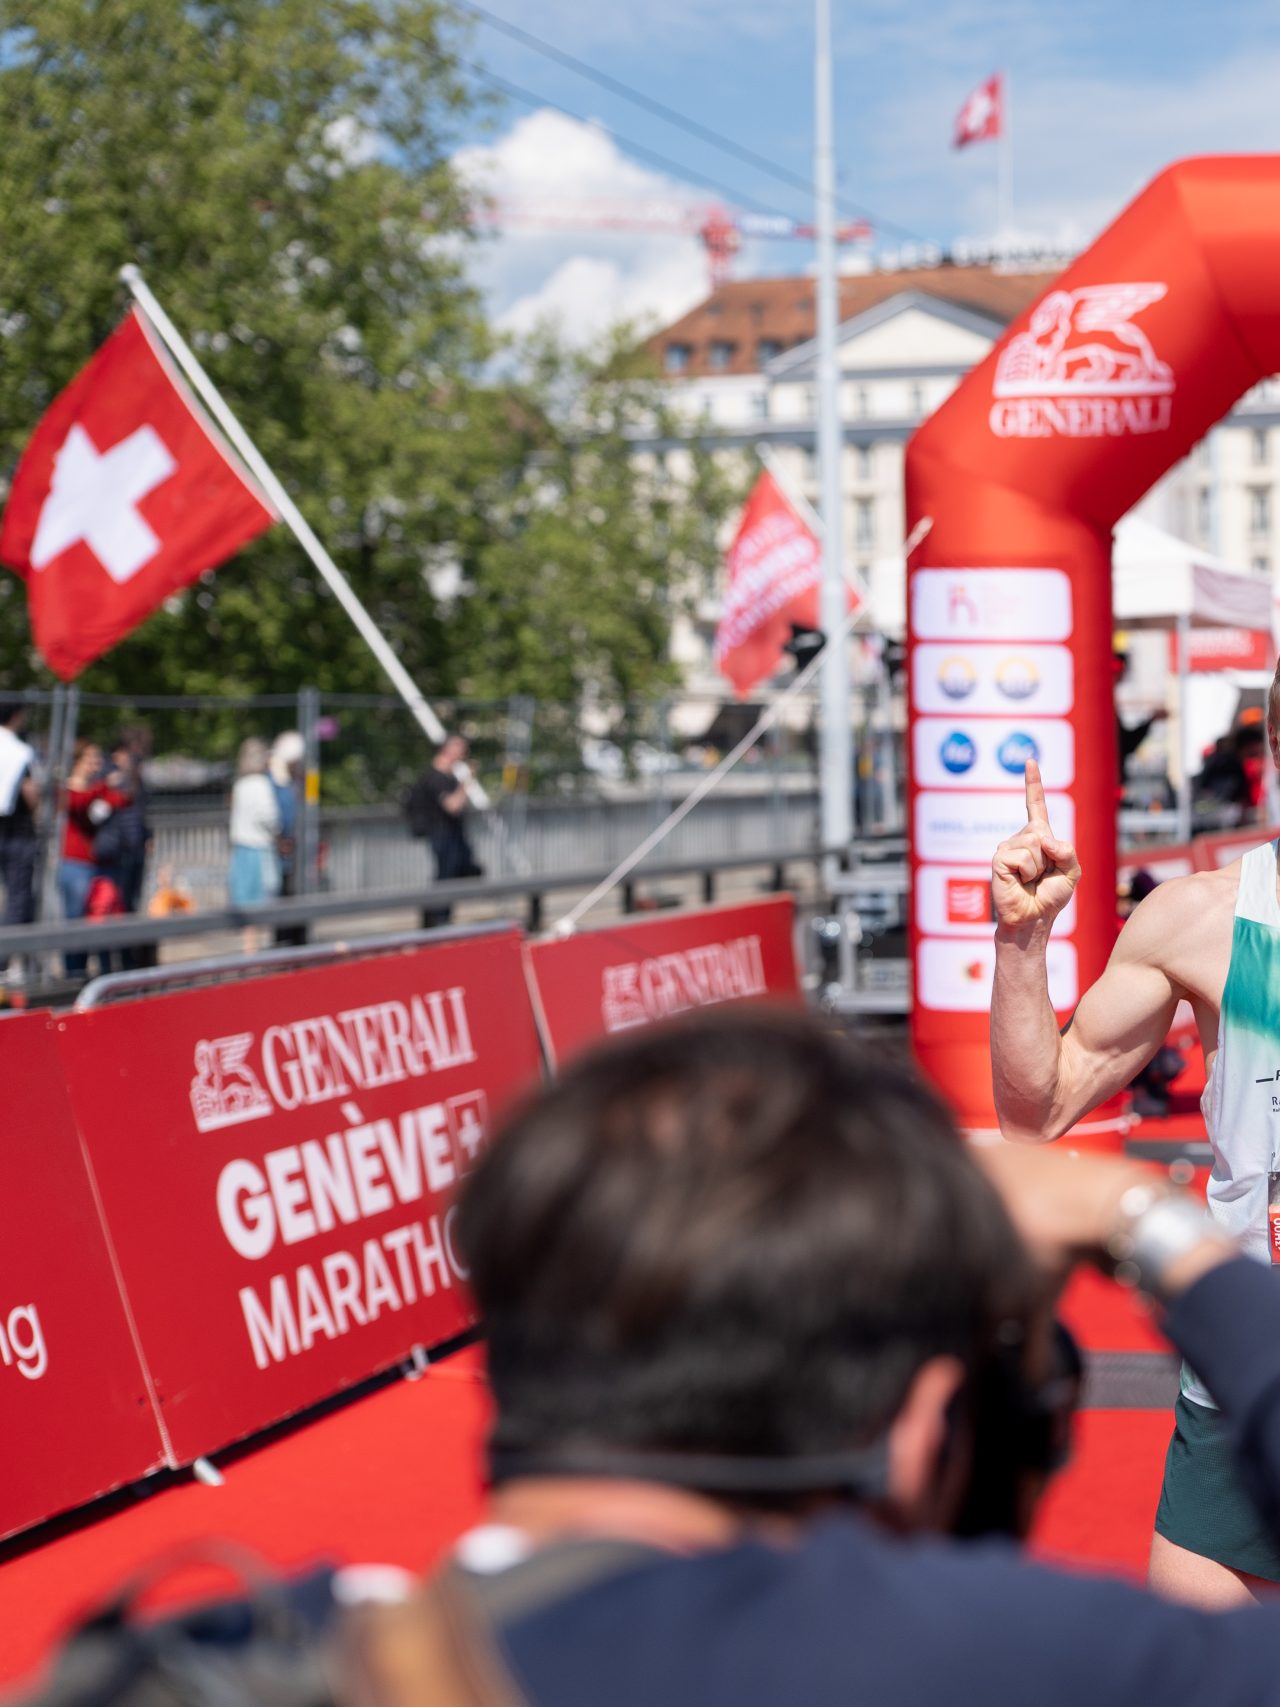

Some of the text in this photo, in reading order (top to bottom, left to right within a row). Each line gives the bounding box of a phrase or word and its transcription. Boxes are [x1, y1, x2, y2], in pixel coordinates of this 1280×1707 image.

[988, 395, 1172, 438] GENERALI
[640, 934, 768, 1021] GENERALI
[261, 986, 478, 1111] GENERALI
[216, 1101, 455, 1261] GENÈVE
